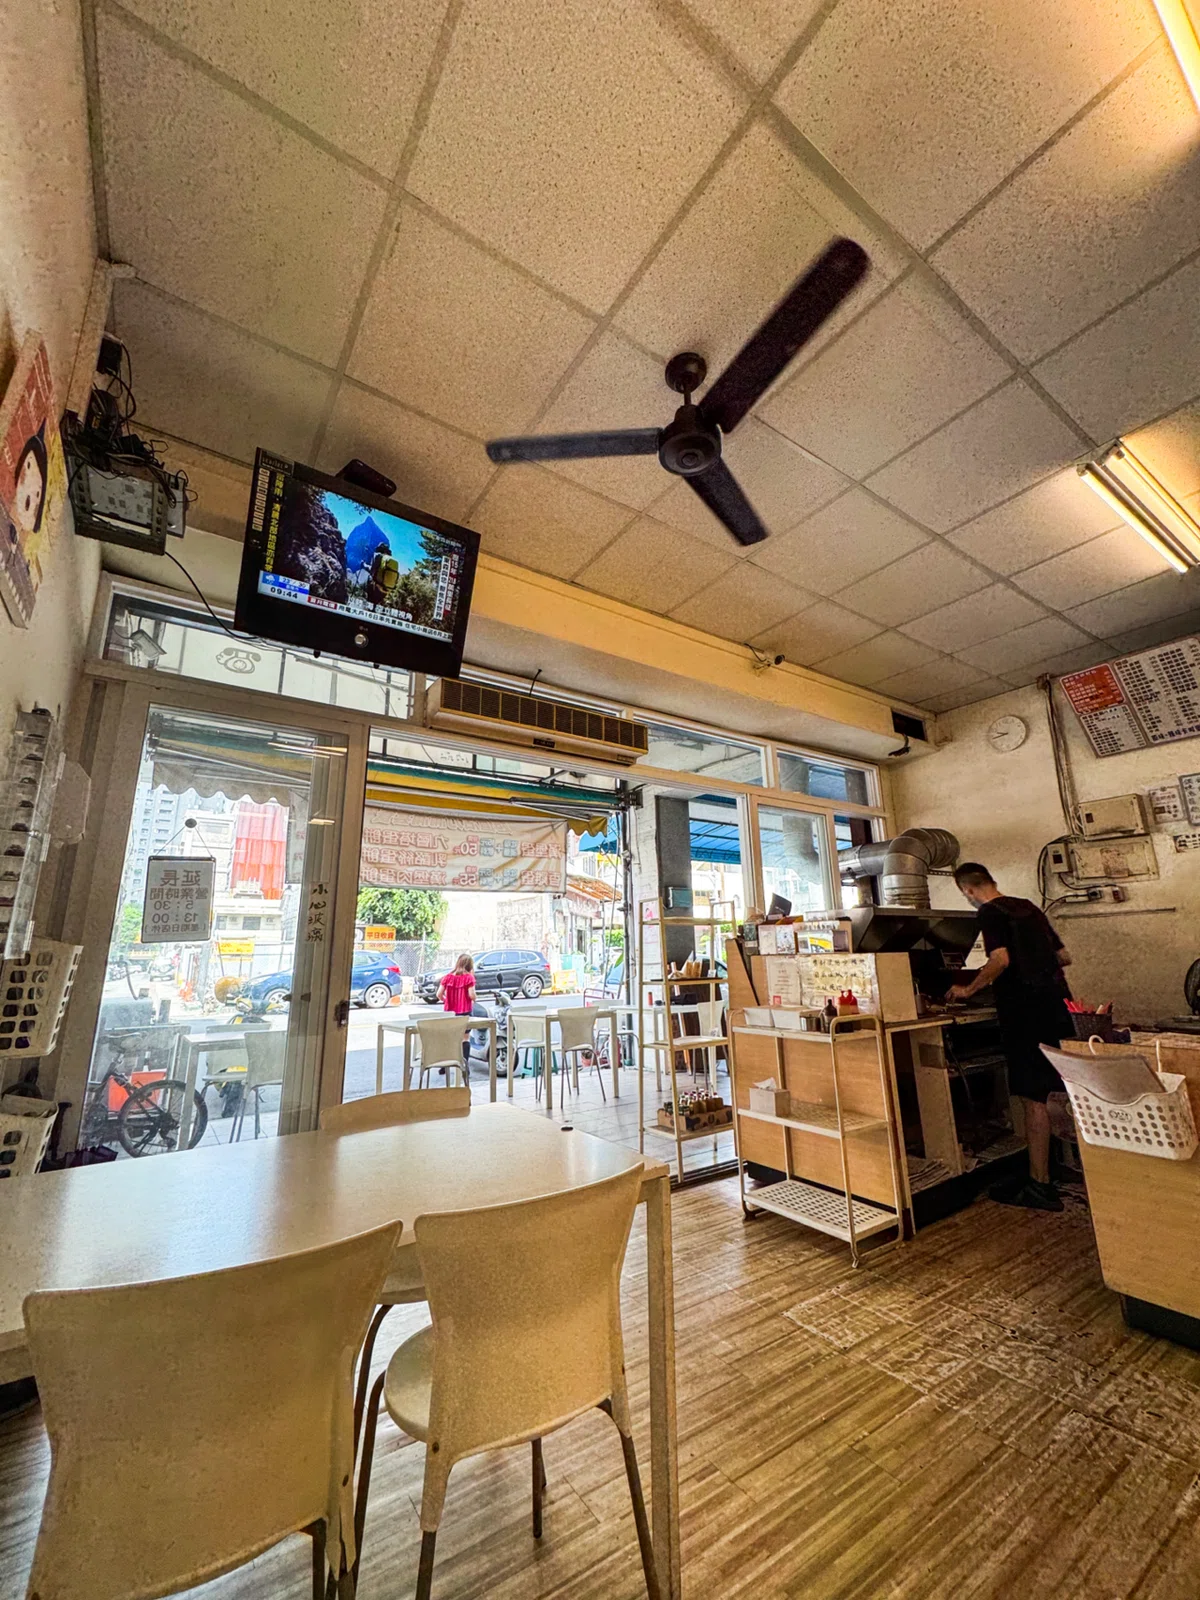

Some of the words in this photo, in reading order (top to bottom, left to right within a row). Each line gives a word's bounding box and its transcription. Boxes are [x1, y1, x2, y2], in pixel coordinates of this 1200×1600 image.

[270, 586, 298, 600] 09:44
[305, 883, 329, 942] 小心玻璃
[366, 931, 394, 940] 平日收費
